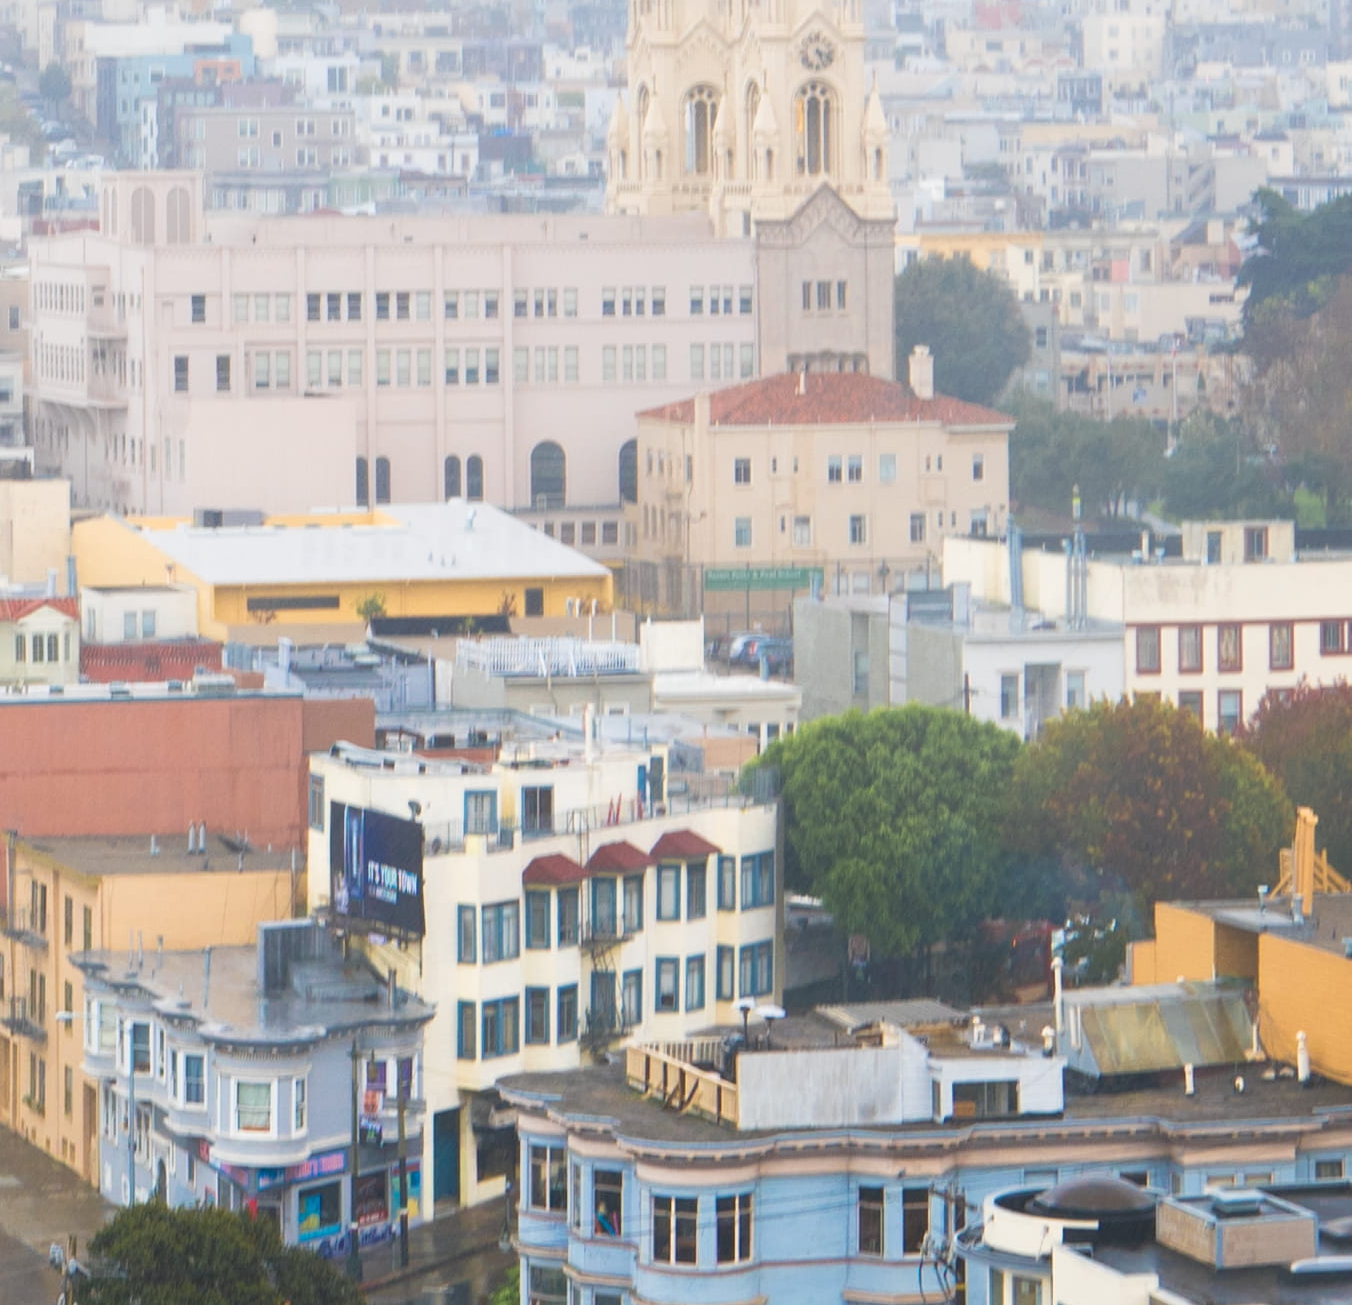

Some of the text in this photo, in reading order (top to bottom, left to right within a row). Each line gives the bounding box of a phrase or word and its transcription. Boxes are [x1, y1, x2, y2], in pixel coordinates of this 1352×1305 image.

[368, 860, 380, 885] IT'S
[381, 863, 397, 889] YOUR
[398, 868, 417, 896] TOWN
